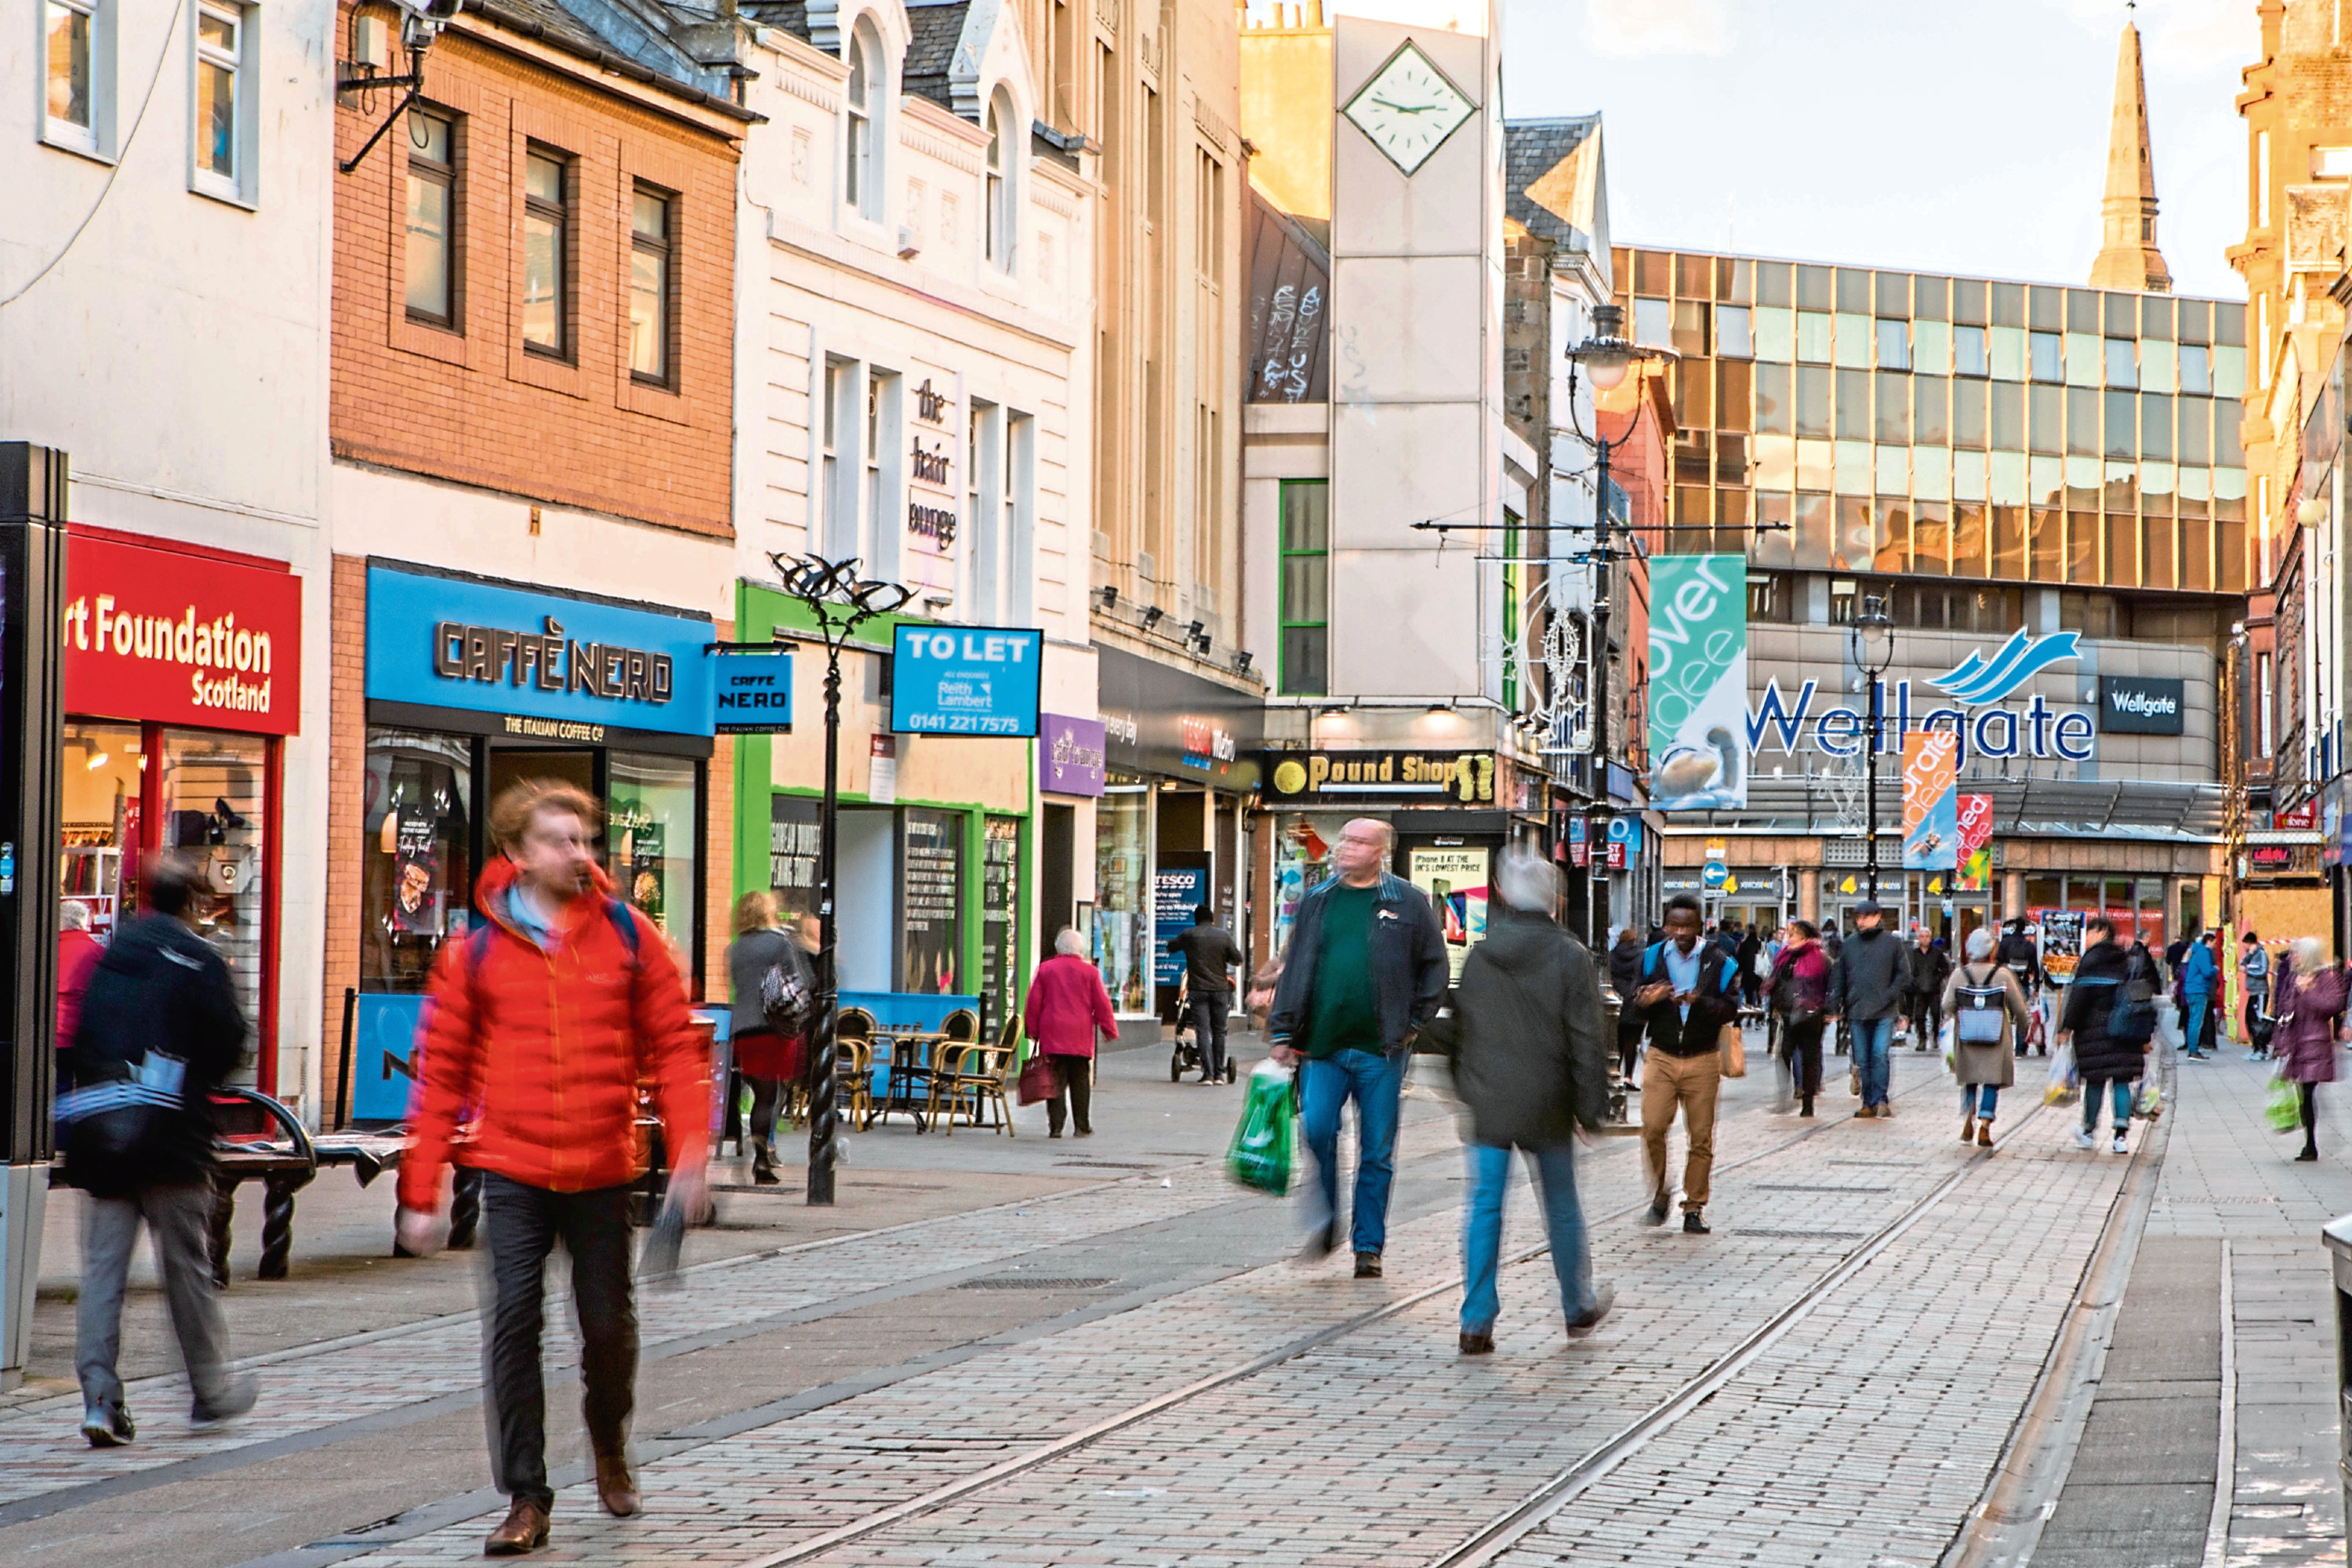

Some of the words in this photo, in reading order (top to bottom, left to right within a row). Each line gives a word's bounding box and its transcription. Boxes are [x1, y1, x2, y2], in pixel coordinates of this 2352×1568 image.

[919, 379, 944, 425] the
[913, 436, 949, 485] hair
[908, 488, 956, 553] lounge
[95, 593, 271, 674] Foundation
[906, 632, 956, 660] TO
[962, 633, 1030, 663] LET
[568, 639, 673, 703] NERO
[191, 669, 271, 713] Scotland
[718, 692, 786, 708] NERO
[937, 692, 993, 709] Lambert
[938, 680, 973, 696] Reith
[2111, 690, 2176, 717] Wellgate
[504, 716, 522, 734] THE
[523, 718, 558, 738] ITALIAN
[559, 722, 591, 741] COFFEE
[909, 713, 946, 730] 0141
[949, 713, 978, 731] 221
[979, 715, 1019, 733] 7575
[1308, 754, 1393, 793] Pound
[1403, 754, 1457, 793] Shop
[1415, 855, 1438, 863] iPhone
[1156, 875, 1196, 886] TESCO
